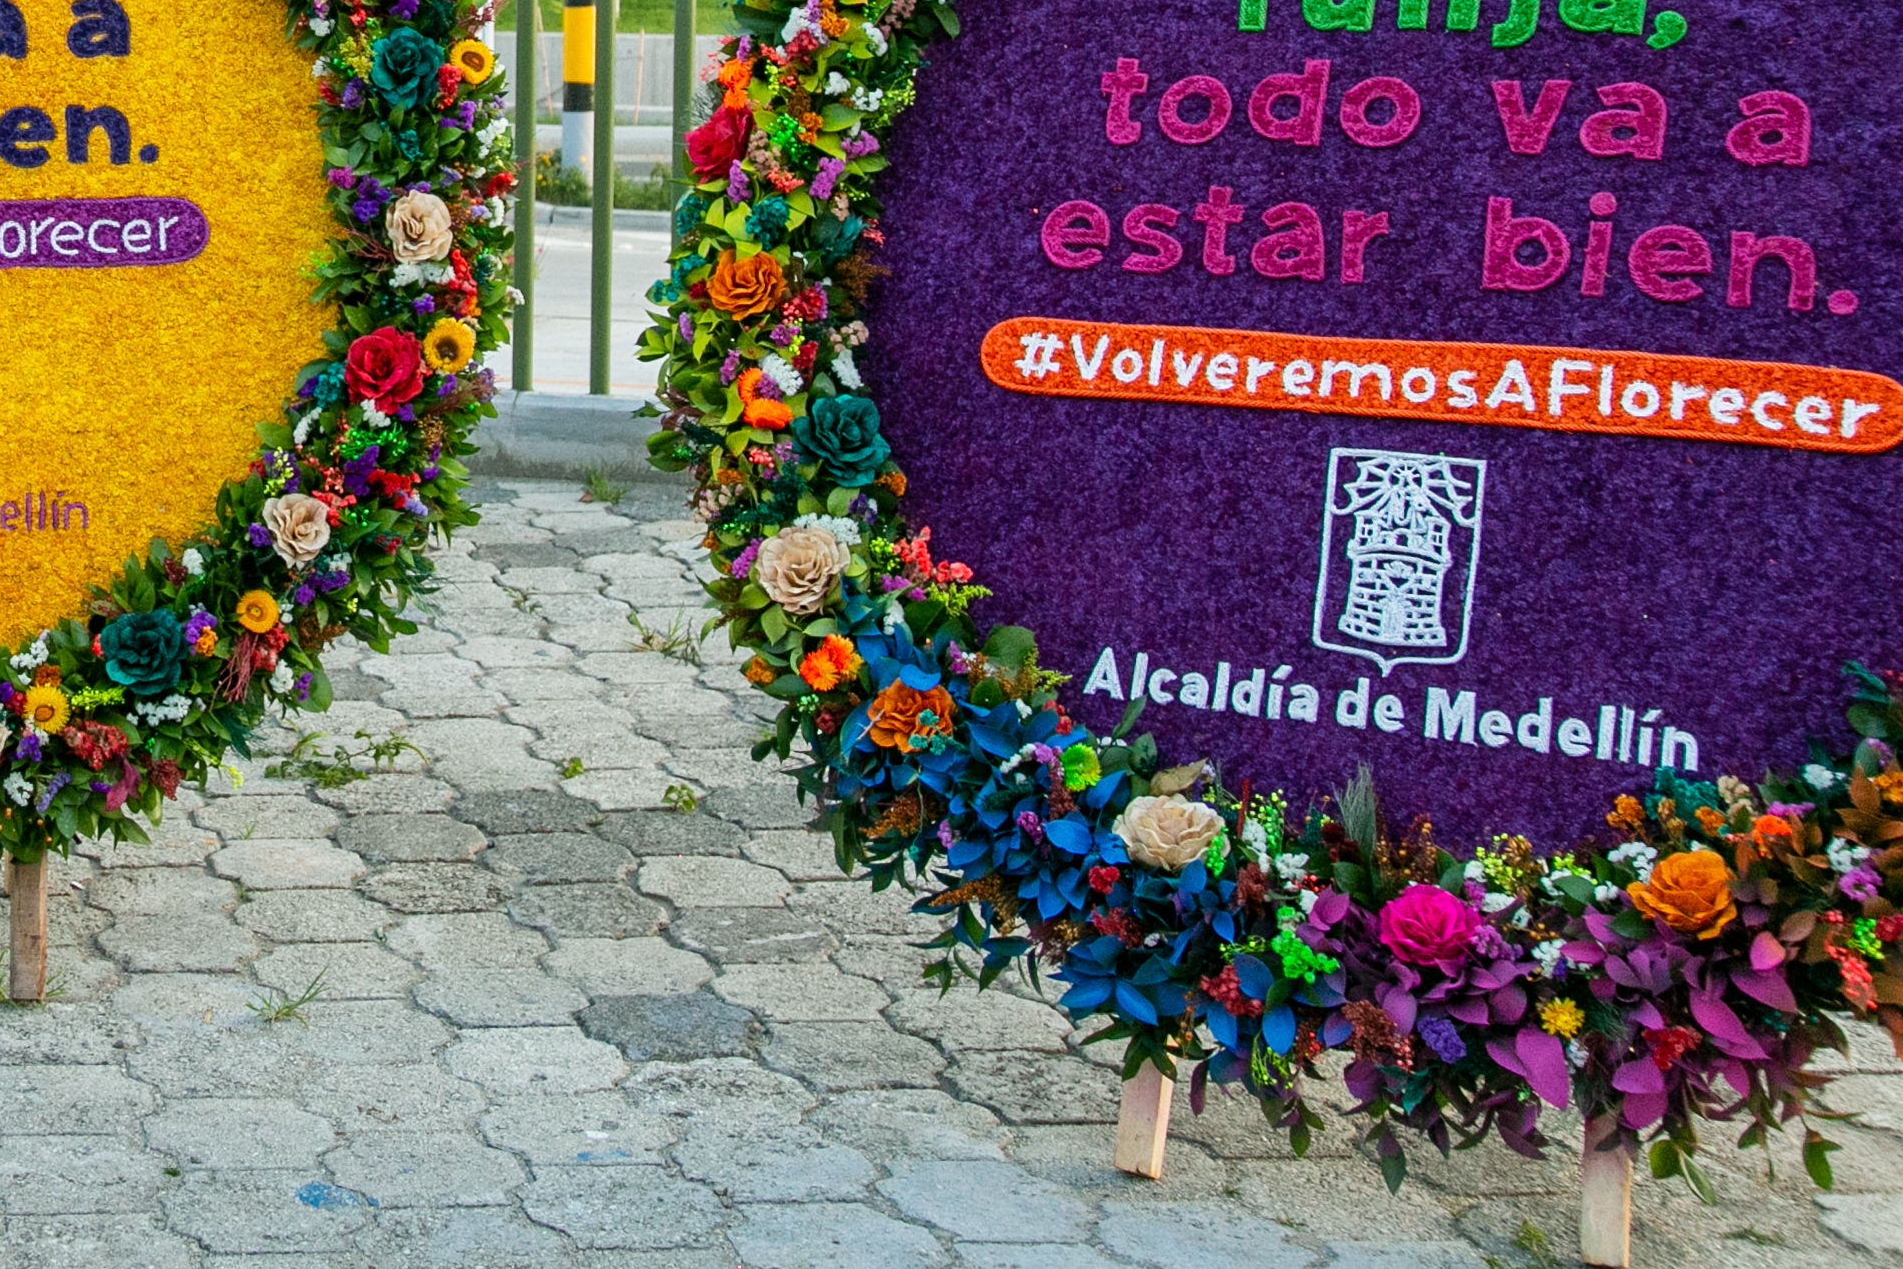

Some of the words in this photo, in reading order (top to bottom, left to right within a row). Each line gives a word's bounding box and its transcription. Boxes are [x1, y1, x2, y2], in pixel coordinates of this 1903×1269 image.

[1100, 57, 1422, 148] todo
[1491, 78, 1668, 161] va
[1725, 89, 1813, 167] a
[1040, 185, 1391, 284] estar
[1483, 191, 1860, 316] bien.
[1013, 332, 1882, 440] #VolveremosAFlorecer
[1083, 647, 1320, 725] Alcaldía
[1335, 677, 1406, 733] de
[1424, 690, 1699, 773] Medellín
